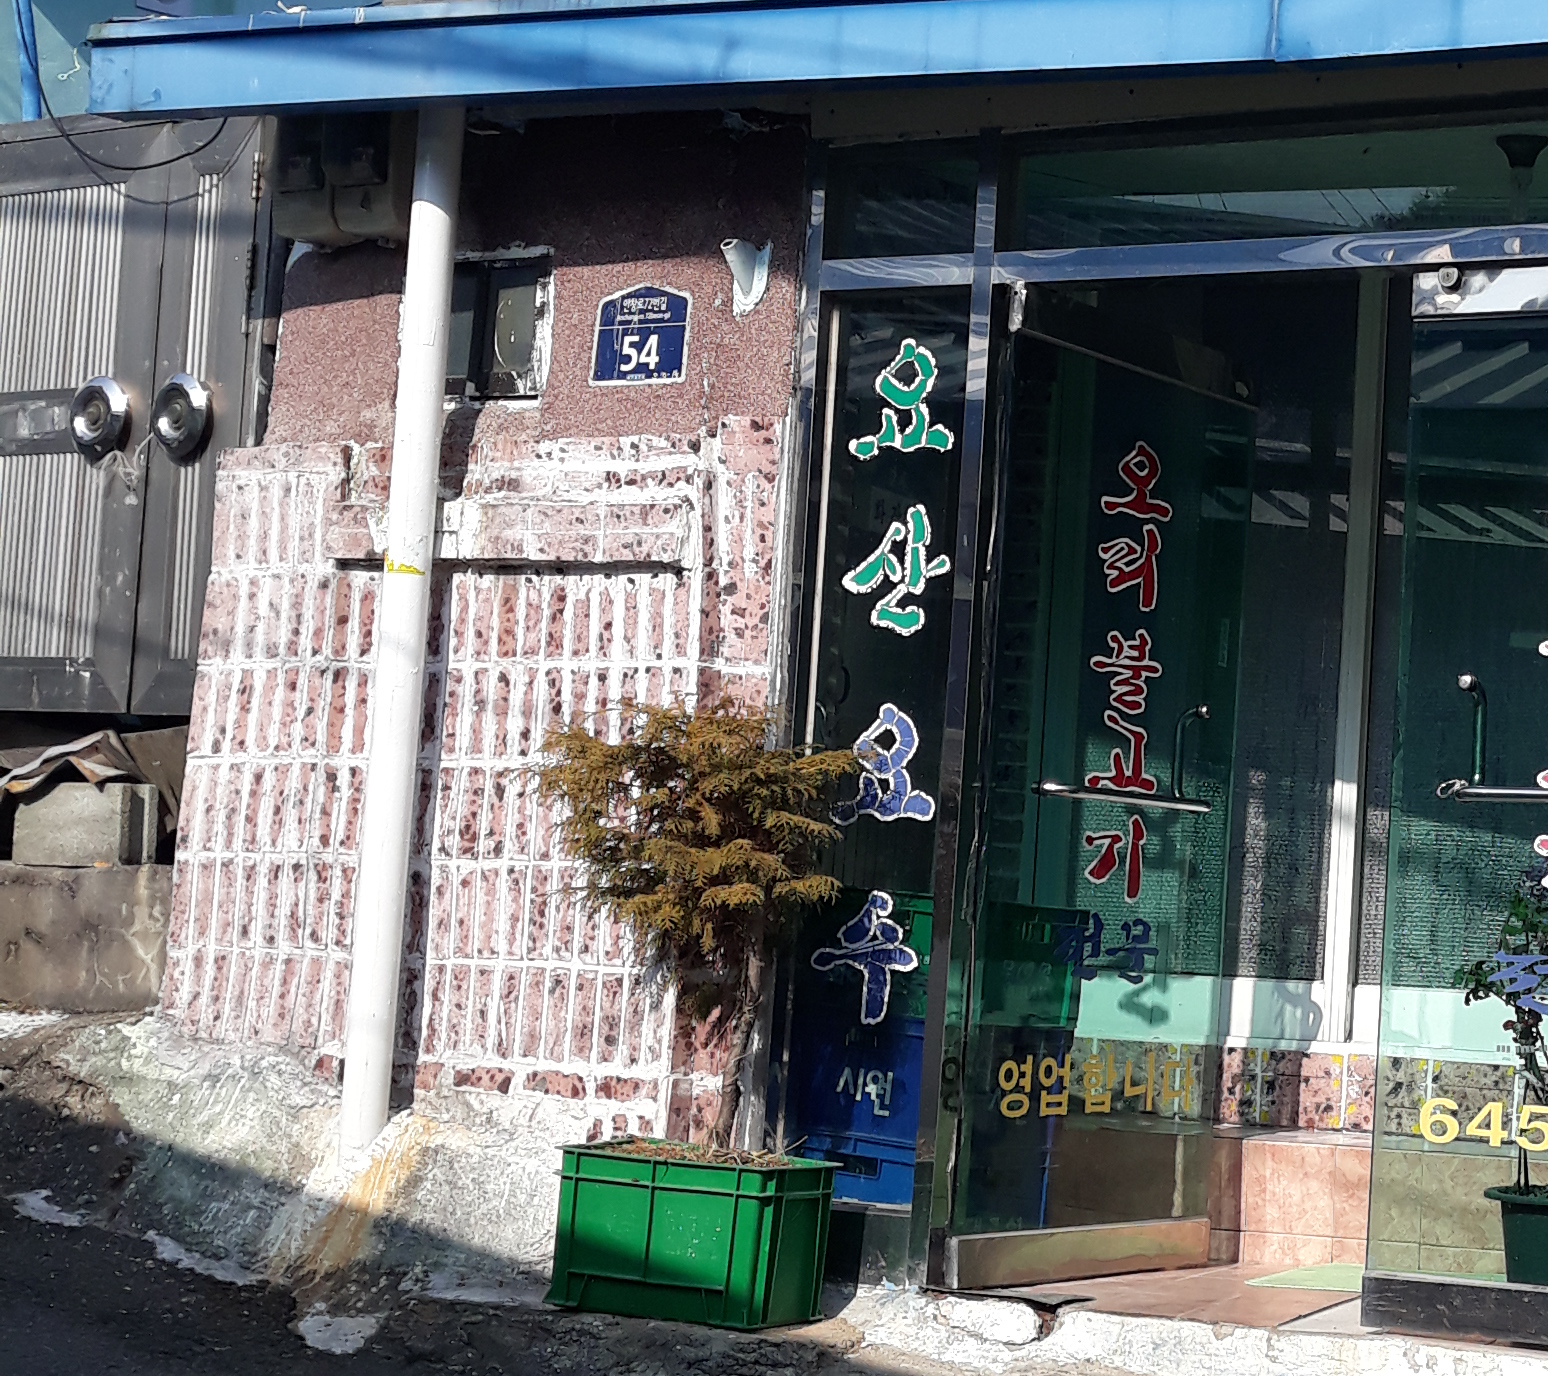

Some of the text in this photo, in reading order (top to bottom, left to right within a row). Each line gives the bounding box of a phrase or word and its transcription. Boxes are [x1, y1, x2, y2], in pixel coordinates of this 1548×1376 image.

[619, 334, 660, 372] 54
[811, 337, 954, 1025] 요산요수
[1083, 439, 1174, 904] 오리불고기
[835, 1066, 895, 1118] 시원
[998, 1053, 1194, 1119] 영업합니다
